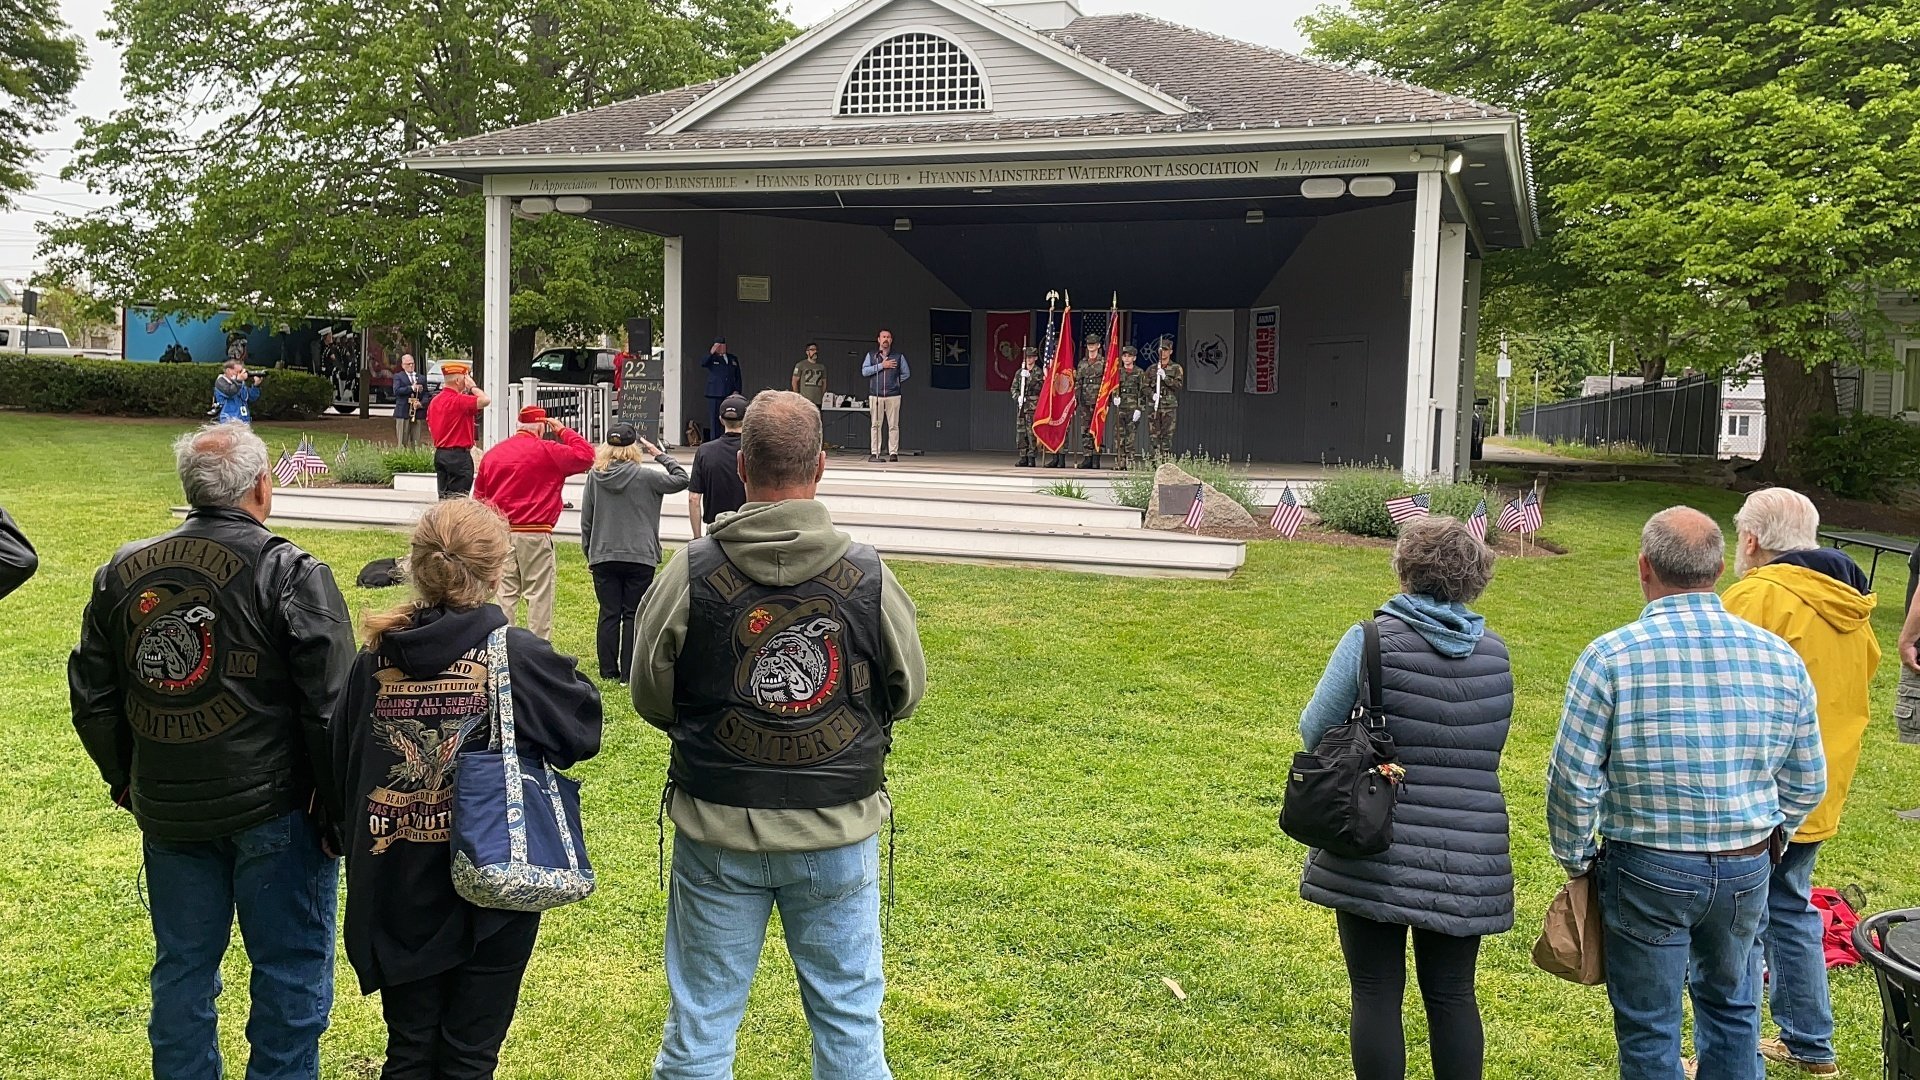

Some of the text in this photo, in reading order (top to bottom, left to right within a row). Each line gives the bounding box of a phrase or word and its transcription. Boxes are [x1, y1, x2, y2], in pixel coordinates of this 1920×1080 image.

[918, 160, 1259, 184] HYANNIS MAINSTREET WATERFRONT ASSOCIATION
[1274, 154, 1370, 174] In Appreciation
[529, 177, 598, 193] In Appreciation
[608, 176, 738, 189] TOWN OF BARNSTABLE
[756, 172, 900, 187] HYANNIS ROTARY CLUB
[1256, 328, 1269, 392] GUARD
[625, 361, 646, 378] 22
[230, 653, 257, 675] MC
[852, 664, 869, 690] MC
[385, 682, 480, 693] THE CONSTITUTION
[375, 696, 488, 709] AGAINST ALL ENEMIES
[128, 693, 245, 740] SEMPER FI
[376, 707, 415, 717] FOREIGN
[417, 707, 438, 716] AND
[719, 710, 859, 762] SEMPER FI
[385, 793, 395, 803] BE
[367, 801, 388, 816] HAS
[369, 814, 389, 835] OF
